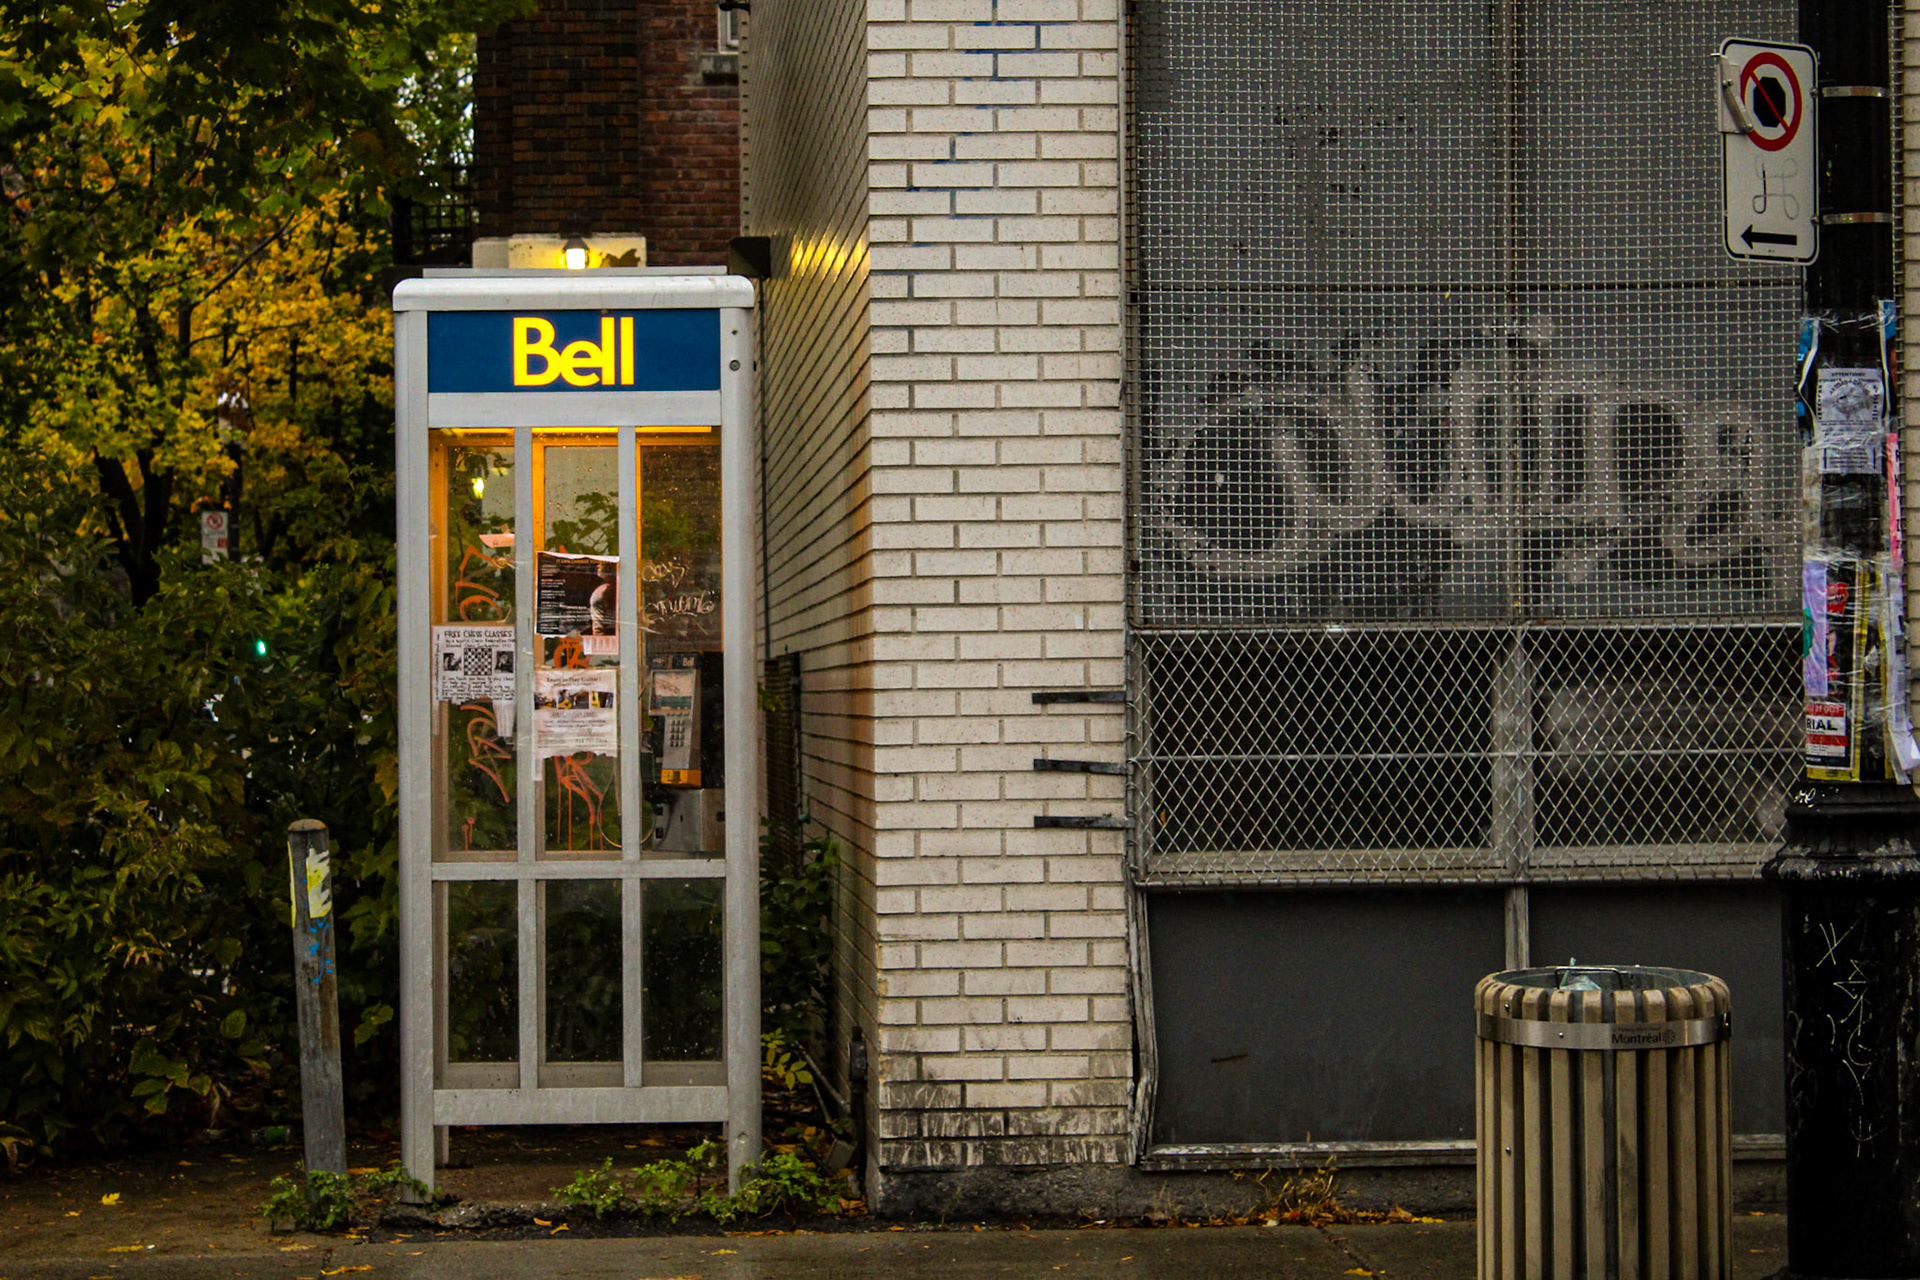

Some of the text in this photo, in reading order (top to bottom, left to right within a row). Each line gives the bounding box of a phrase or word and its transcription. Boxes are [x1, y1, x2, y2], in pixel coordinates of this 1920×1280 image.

[512, 316, 635, 387] Bell
[444, 630, 513, 638] FREE CHESS CLASSES
[682, 657, 694, 667] Bell
[1611, 1032, 1662, 1044] Montréal
